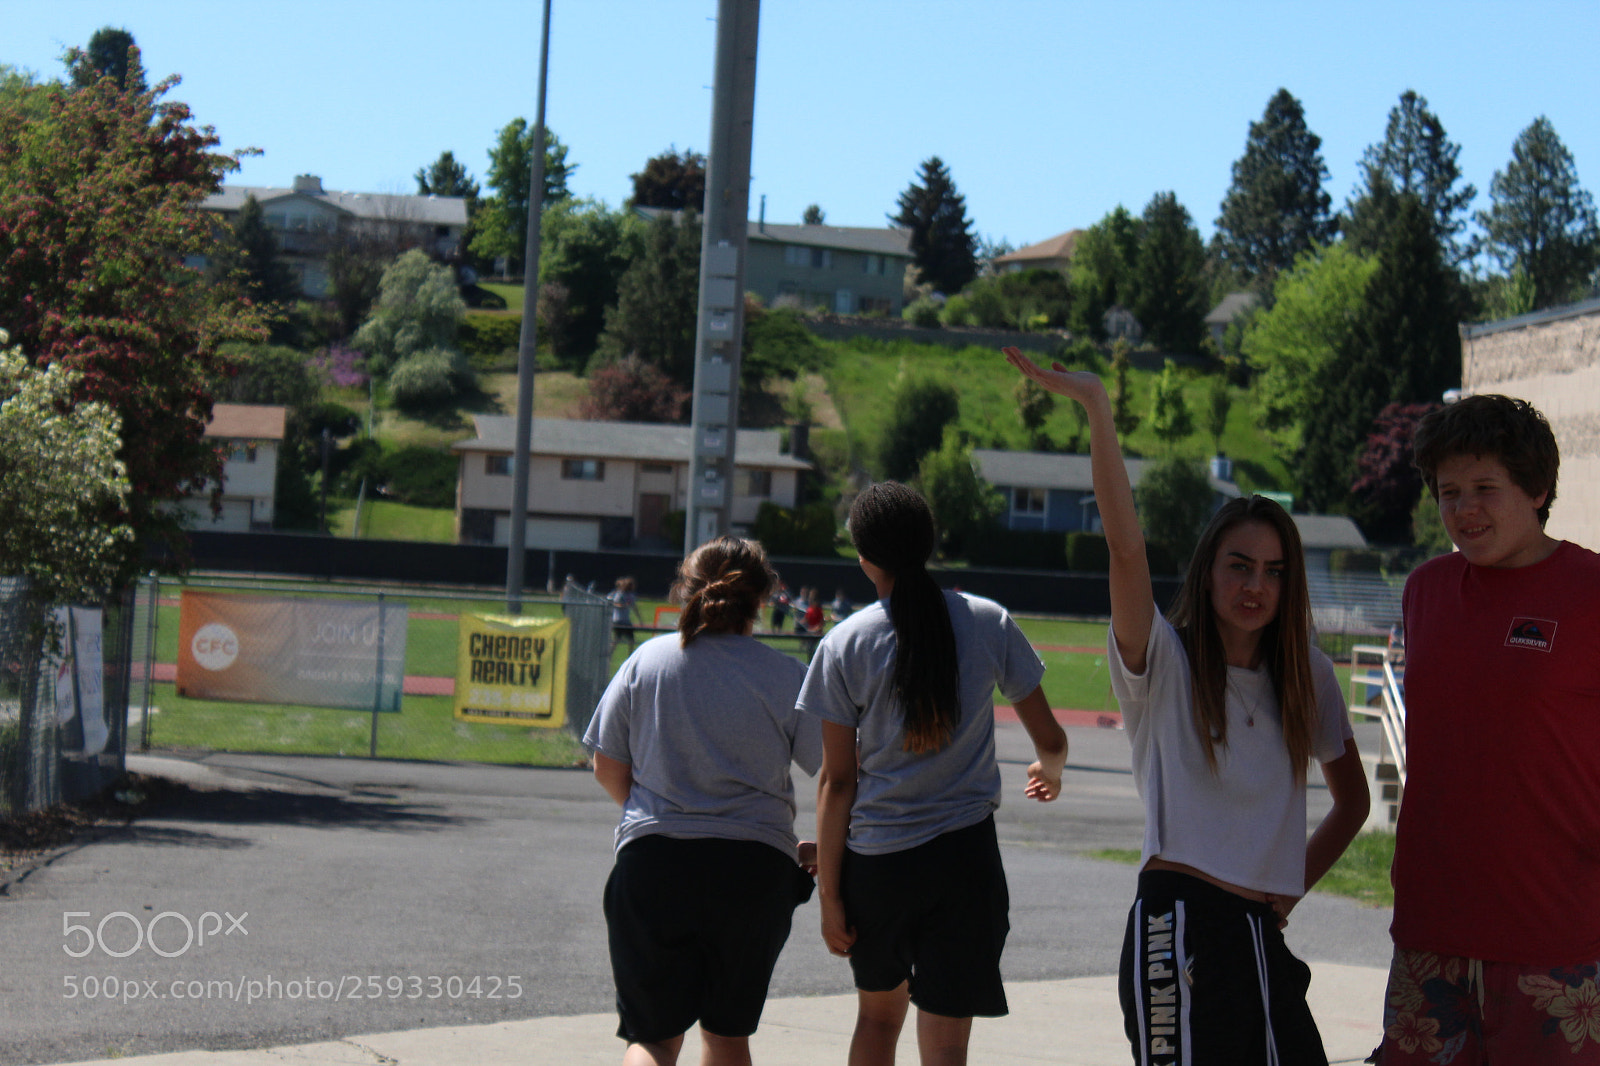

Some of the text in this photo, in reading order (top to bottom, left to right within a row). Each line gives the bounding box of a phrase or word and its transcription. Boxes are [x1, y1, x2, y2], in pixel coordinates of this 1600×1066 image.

[195, 637, 235, 656] CFC
[310, 622, 357, 645] JOIN
[469, 632, 545, 661] CHENEY
[470, 659, 541, 687] REALTY
[1148, 911, 1173, 980] PINK
[1151, 983, 1176, 1055] PINK
